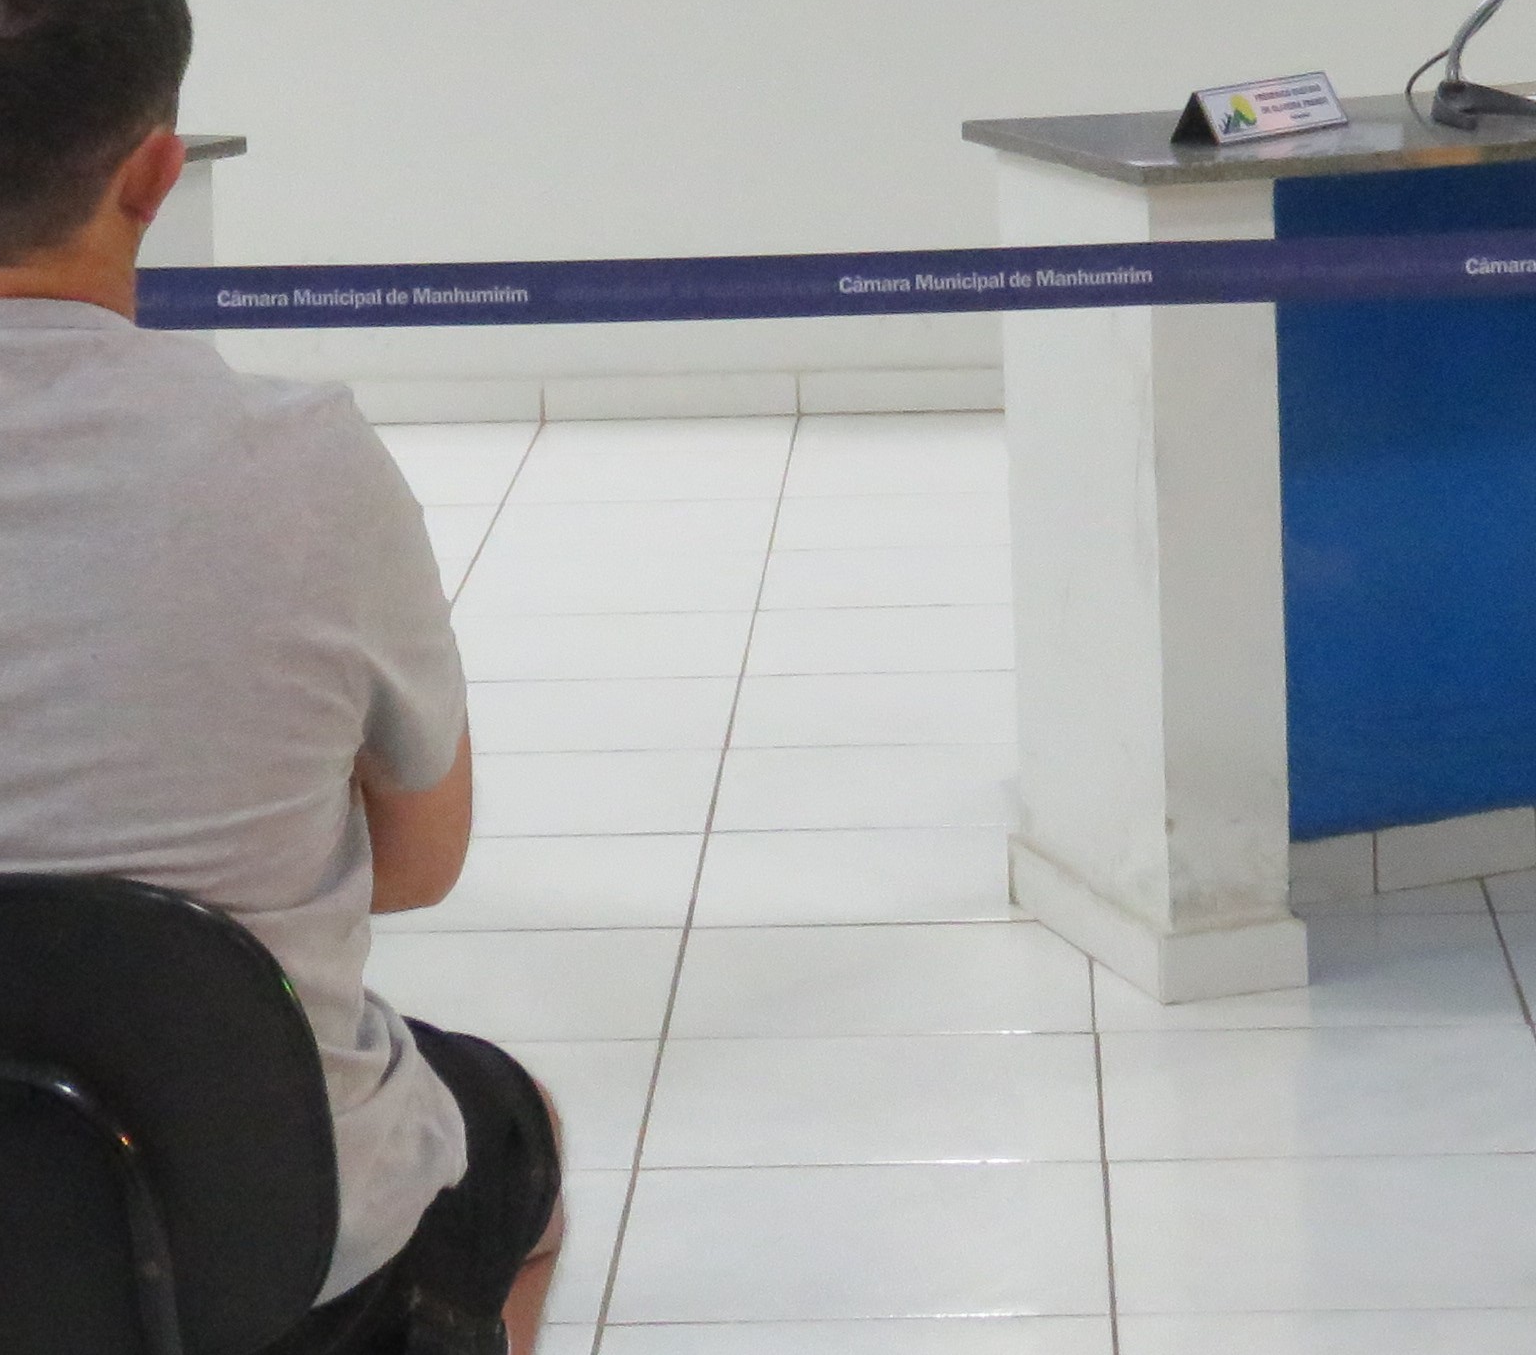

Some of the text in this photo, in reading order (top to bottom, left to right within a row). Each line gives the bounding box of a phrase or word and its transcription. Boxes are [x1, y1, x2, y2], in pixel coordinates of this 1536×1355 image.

[838, 267, 1153, 294] Câmara Municipal de Manhumirim
[216, 285, 529, 309] Câmara Municipal de Manhumirim
